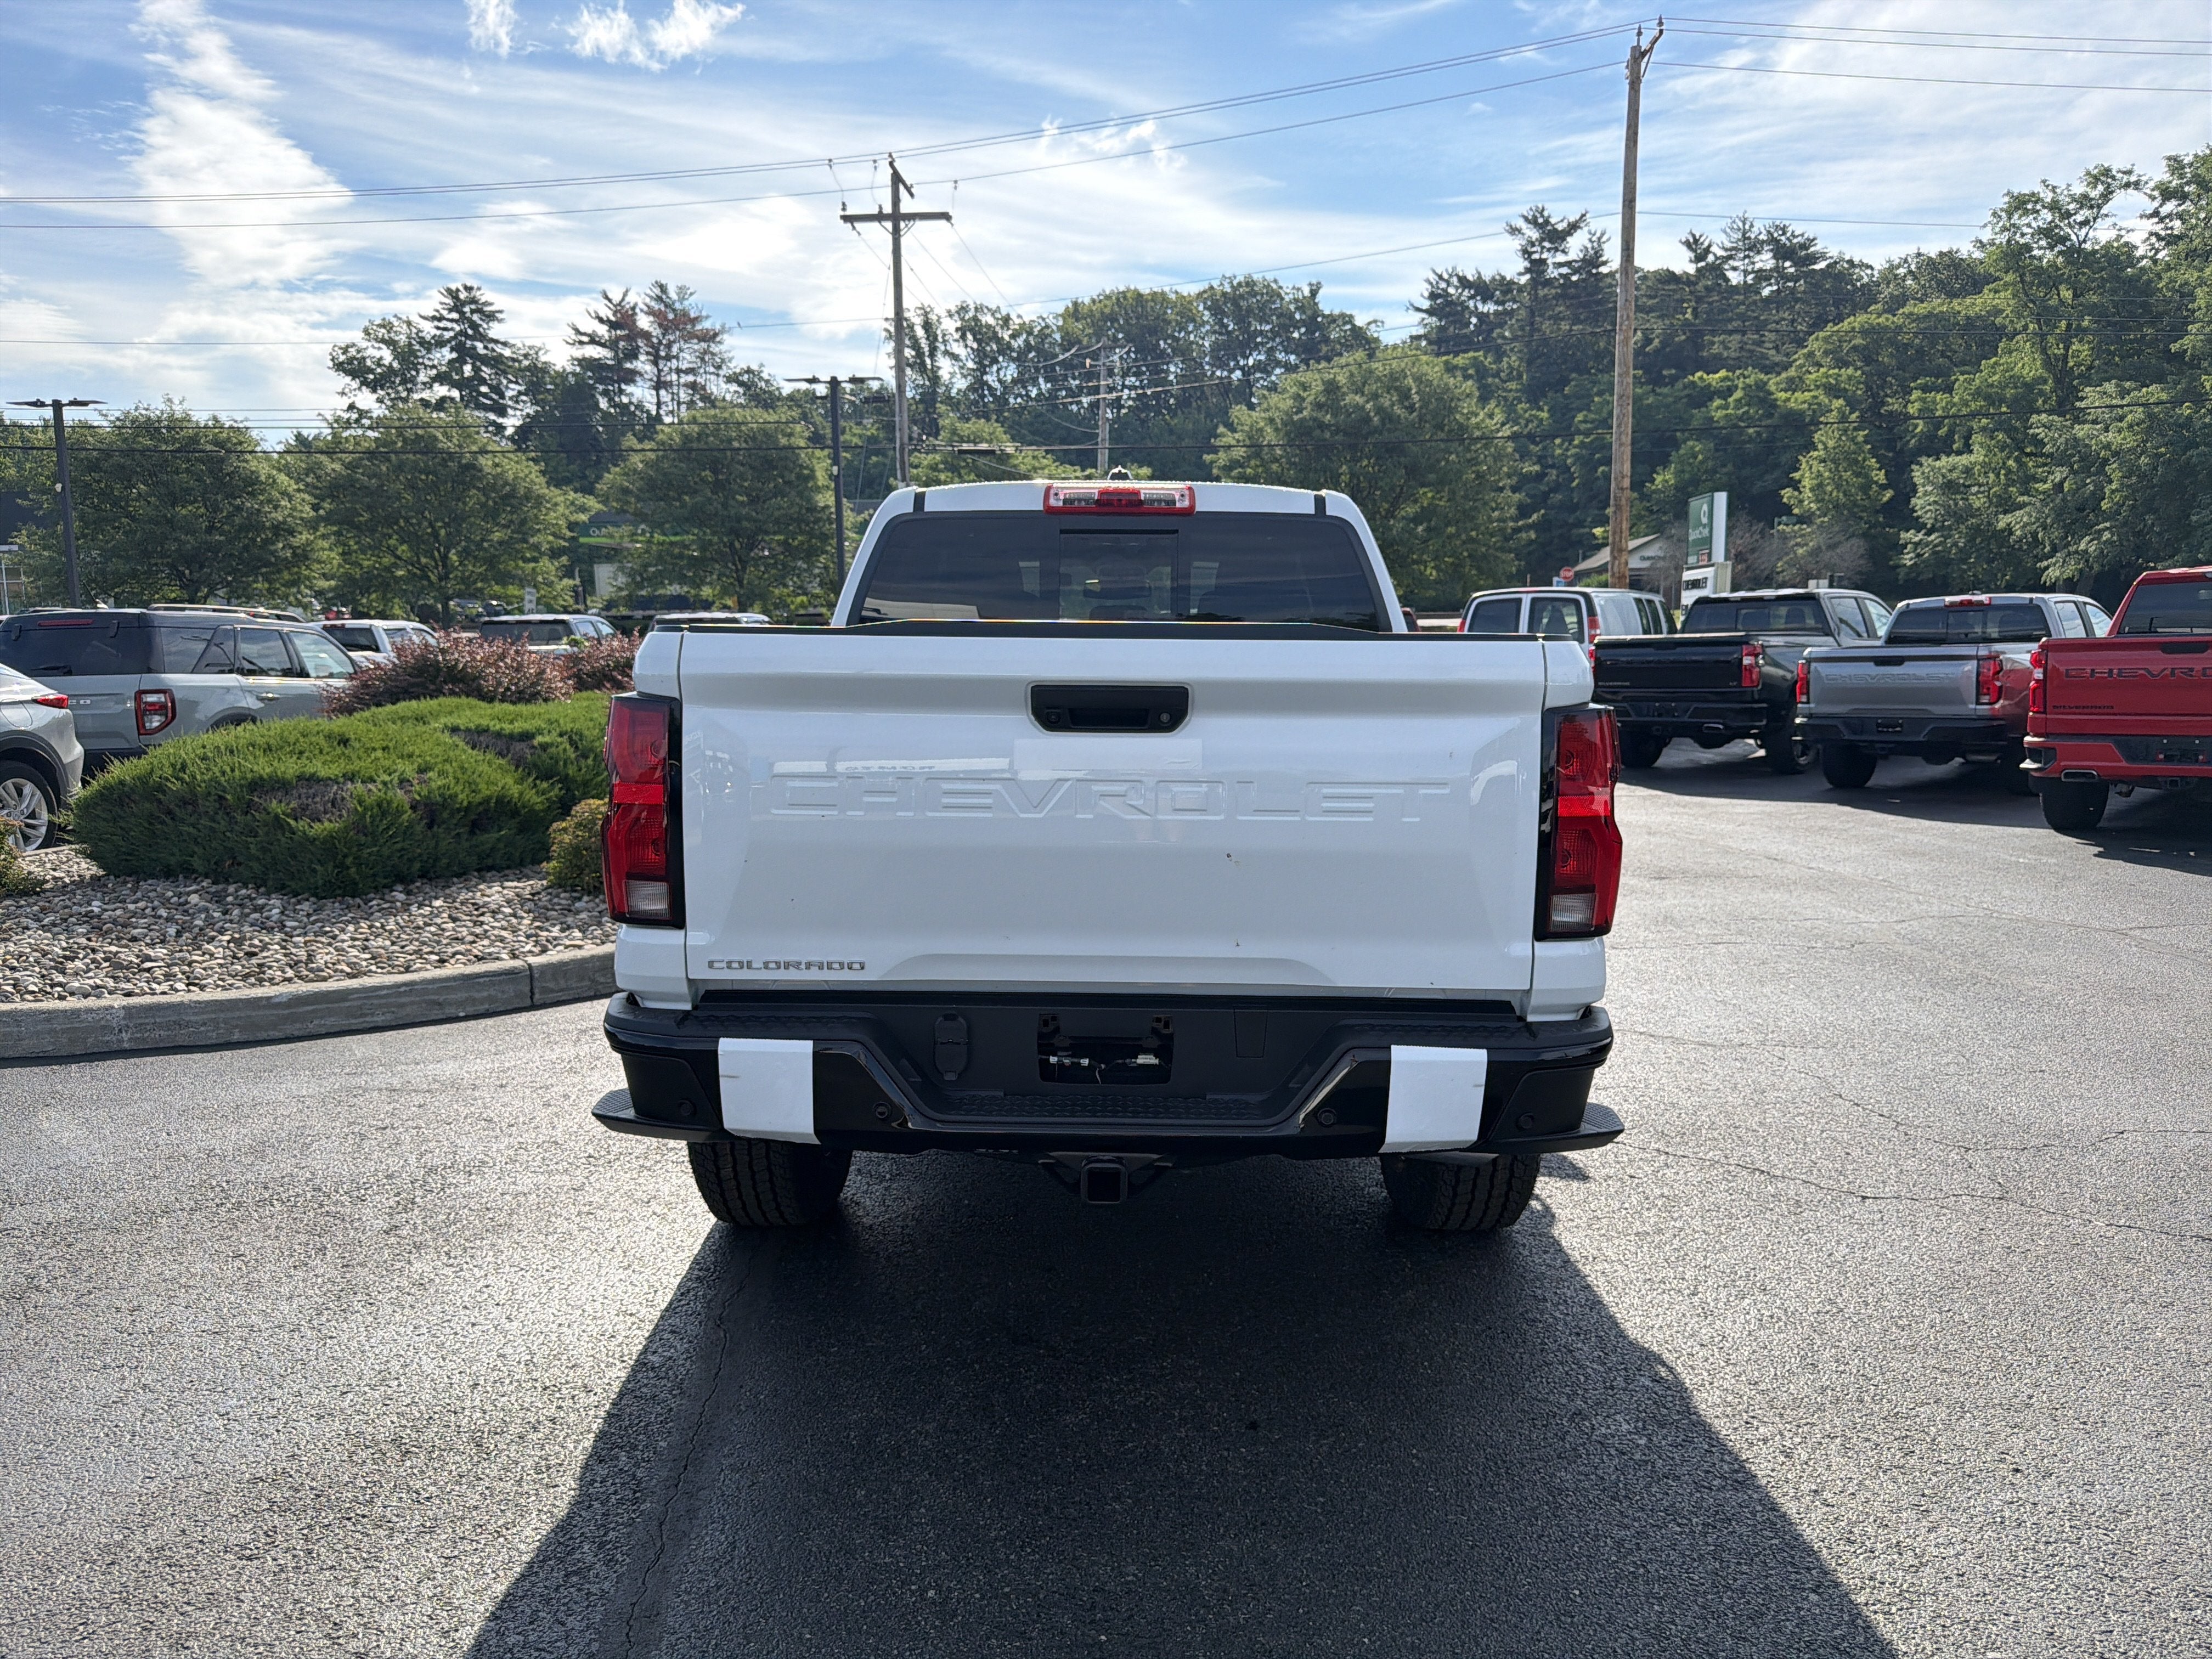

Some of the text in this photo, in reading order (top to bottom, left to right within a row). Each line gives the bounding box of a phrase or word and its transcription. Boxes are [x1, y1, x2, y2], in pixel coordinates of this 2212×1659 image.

[1825, 673, 1956, 684] CHEVROLET
[770, 775, 1450, 822] CHEVROLET
[708, 959, 865, 970] COLORADO
